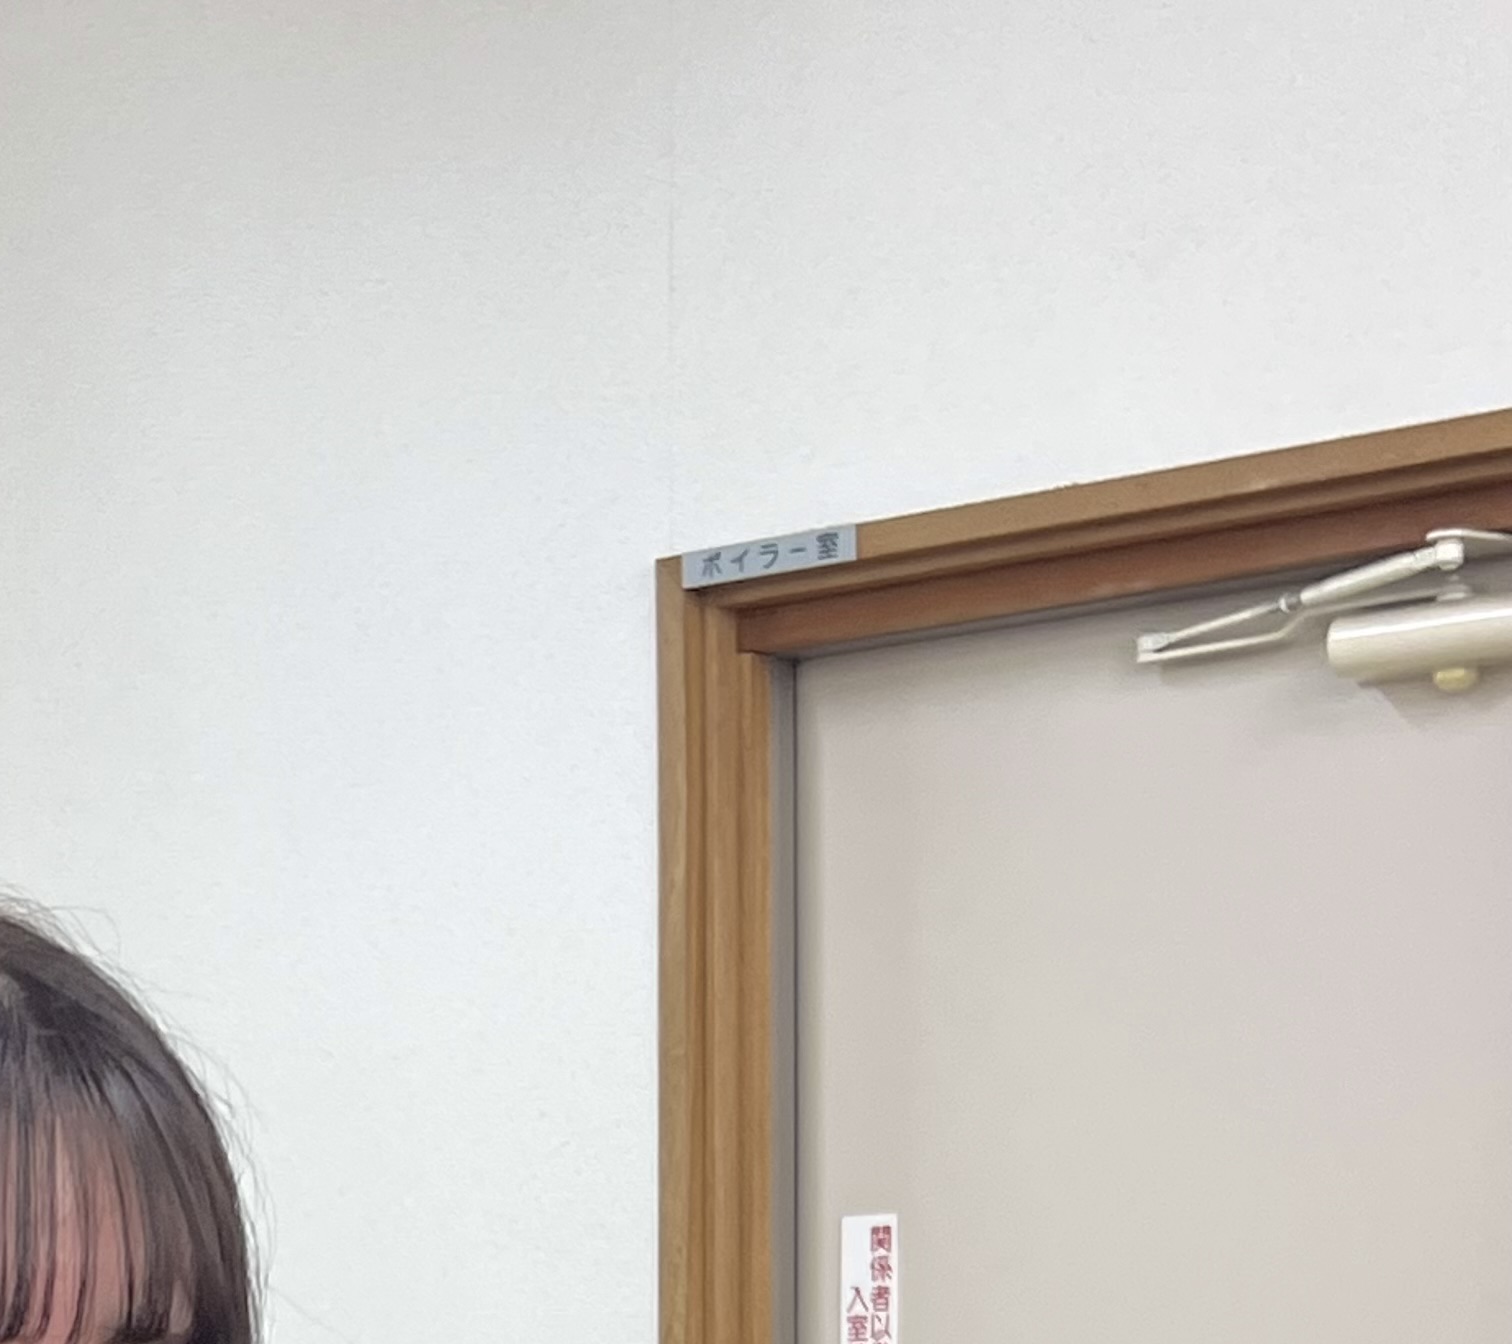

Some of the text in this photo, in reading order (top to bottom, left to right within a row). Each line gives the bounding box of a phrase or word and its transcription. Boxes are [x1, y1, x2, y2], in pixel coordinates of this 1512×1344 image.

[702, 532, 839, 577] ボイラー室
